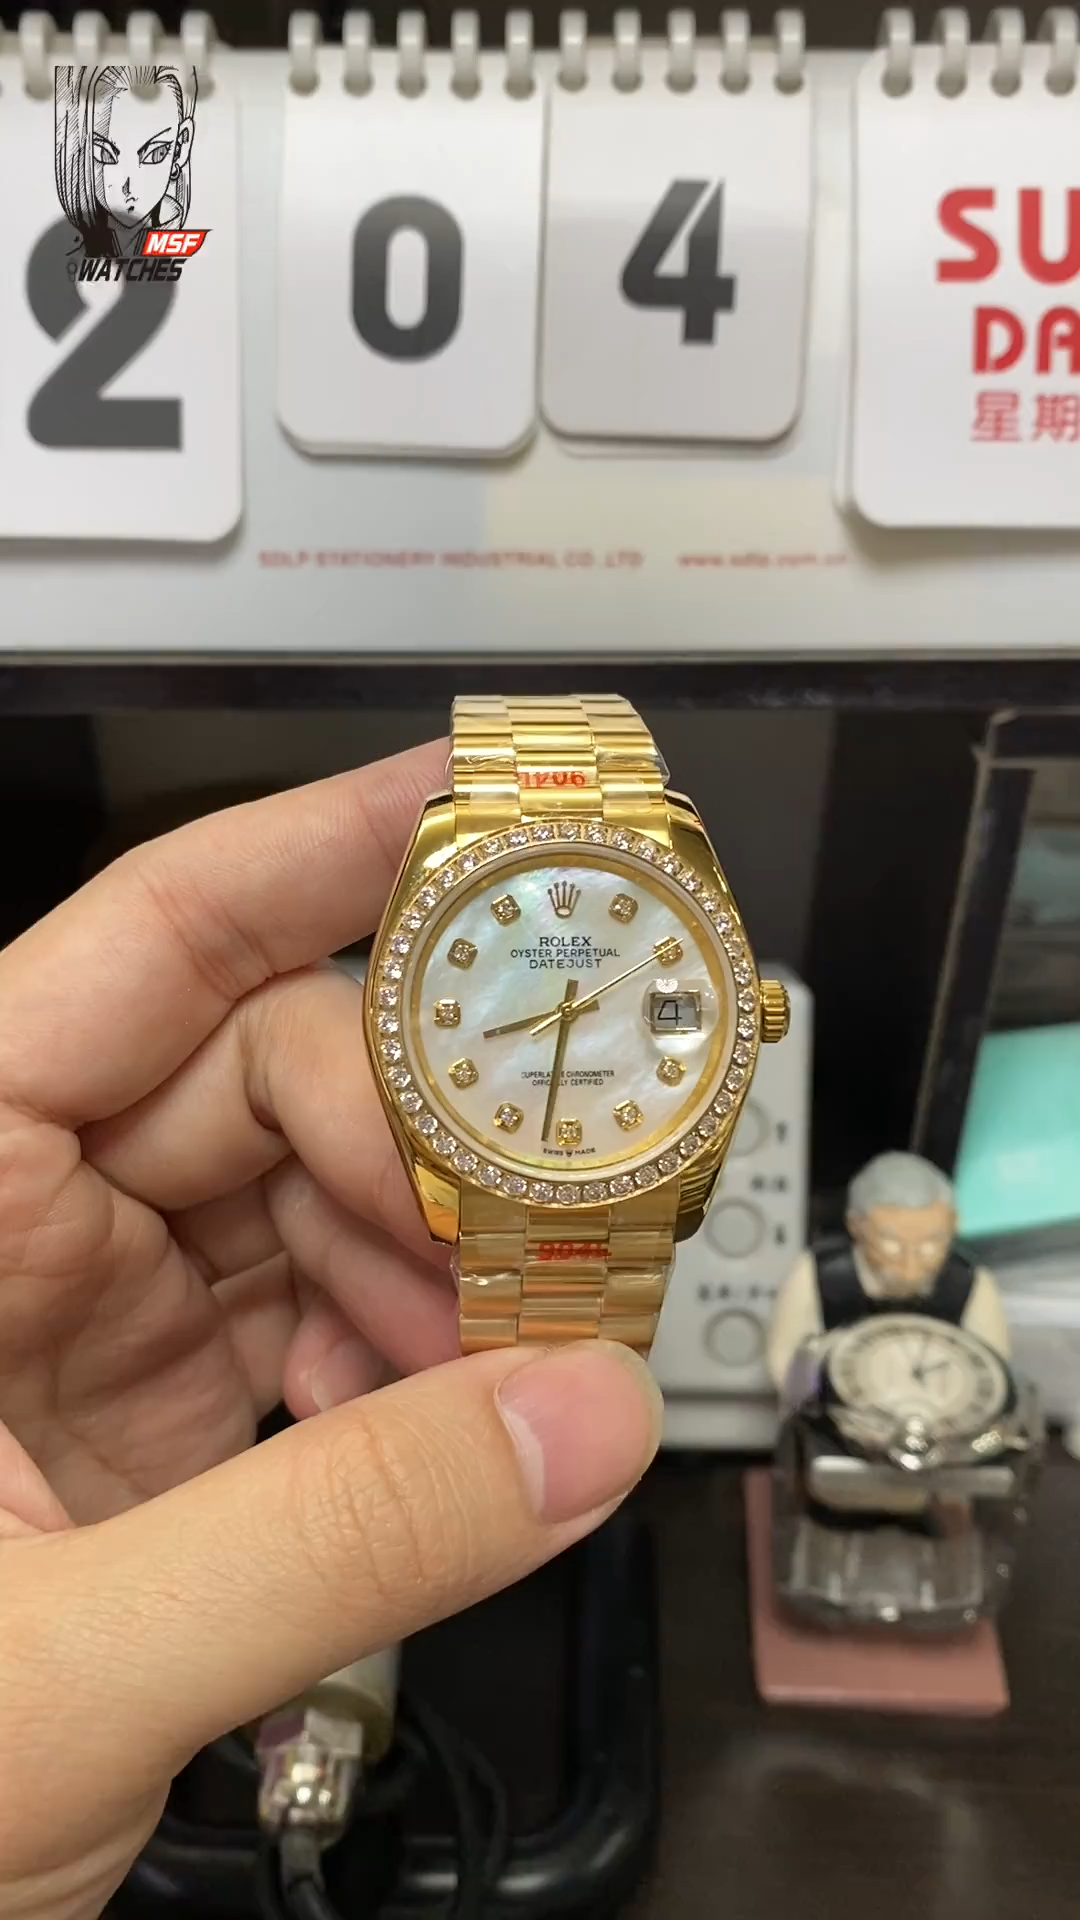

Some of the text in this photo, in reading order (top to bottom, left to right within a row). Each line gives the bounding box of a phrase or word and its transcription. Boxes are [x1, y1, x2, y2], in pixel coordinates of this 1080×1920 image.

[619, 181, 736, 344] 4
[26, 212, 183, 451] 2
[972, 305, 1080, 374] DA
[970, 391, 1080, 441] 星期
[539, 936, 592, 947] ROLEX
[510, 948, 621, 958] OYSTER PERPETUAL
[529, 958, 602, 969] DATEJUST
[657, 1000, 683, 1025] 4
[566, 1070, 615, 1078] CHRONOMETER
[574, 1147, 596, 1155] MADE
